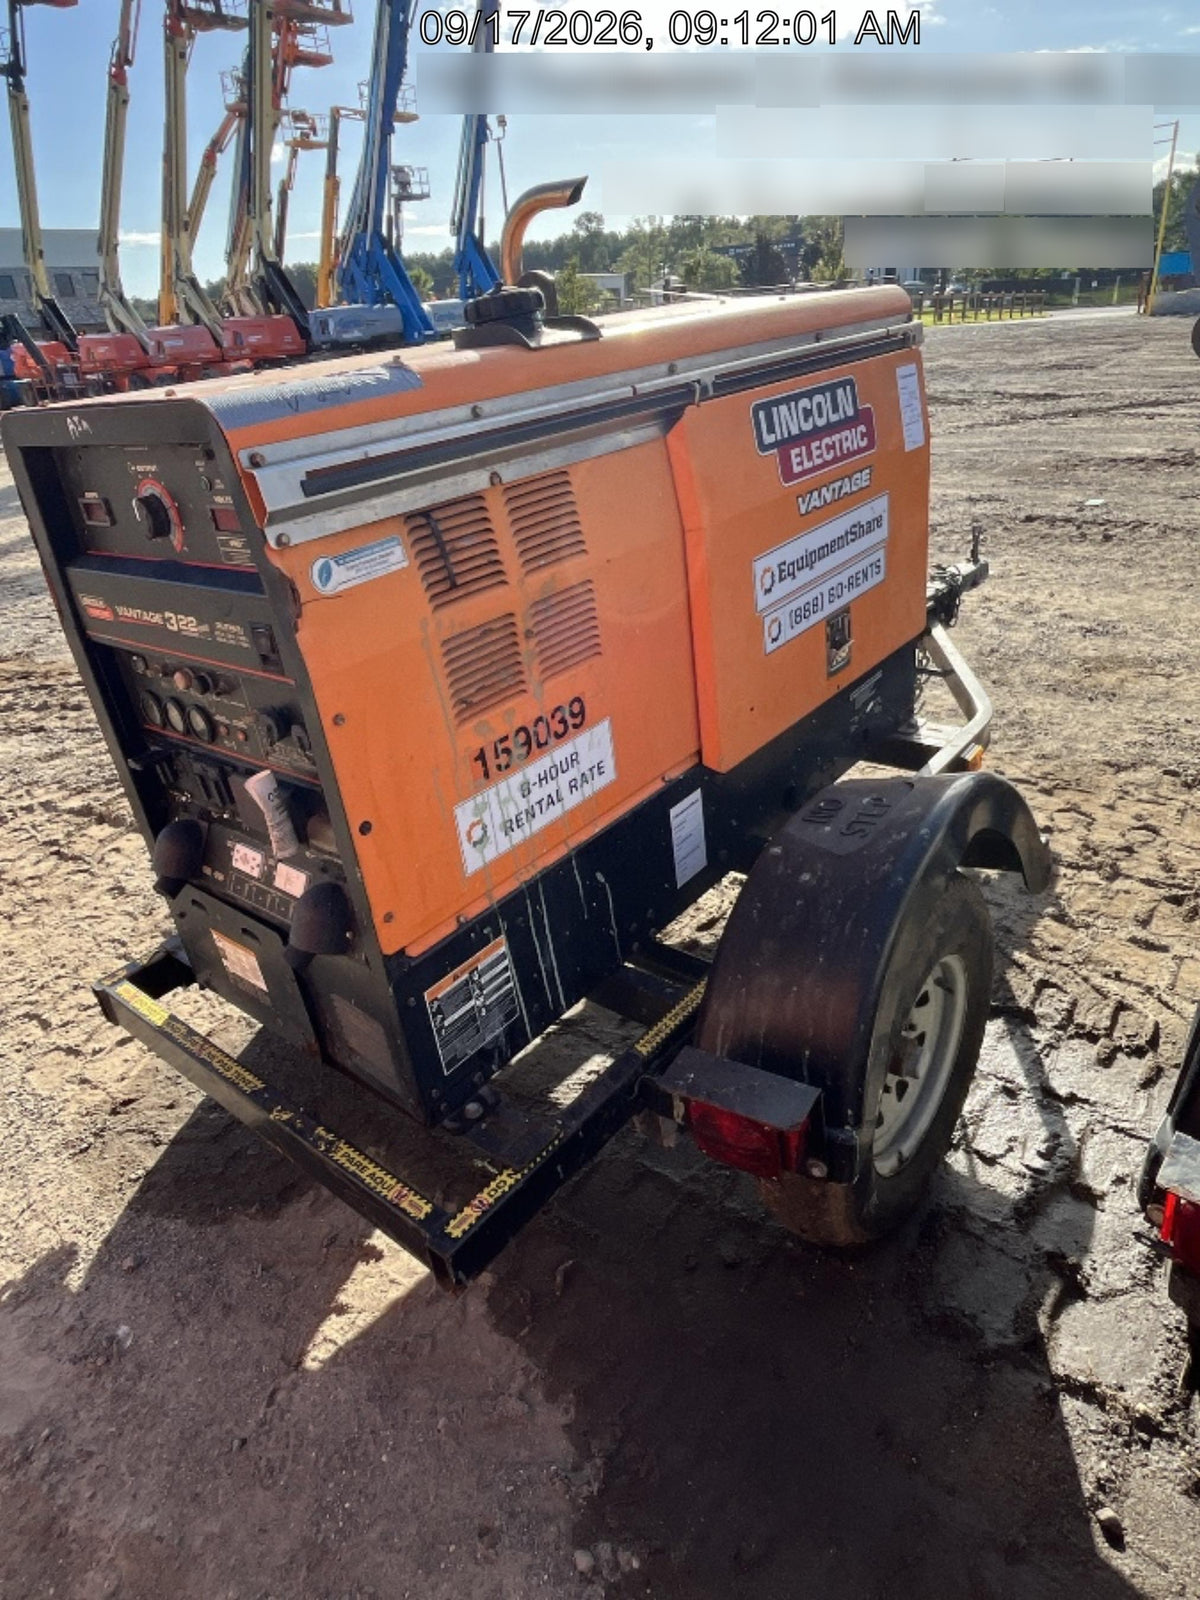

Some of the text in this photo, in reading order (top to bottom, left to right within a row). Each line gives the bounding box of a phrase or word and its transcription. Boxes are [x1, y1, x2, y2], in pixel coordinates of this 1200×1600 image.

[759, 385, 854, 445] LINCOLN
[790, 424, 868, 474] ELECTRIC
[796, 466, 873, 516] VANTAGE
[776, 514, 883, 583] EquipmentShare
[115, 605, 164, 625] VANTAGE
[164, 611, 198, 632] 322
[788, 592, 824, 630] (888)
[474, 696, 586, 780] 159039
[504, 760, 606, 836] RENTAL RATE
[520, 751, 580, 799] 8-HOUR
[340, 1151, 370, 1175] PARE
